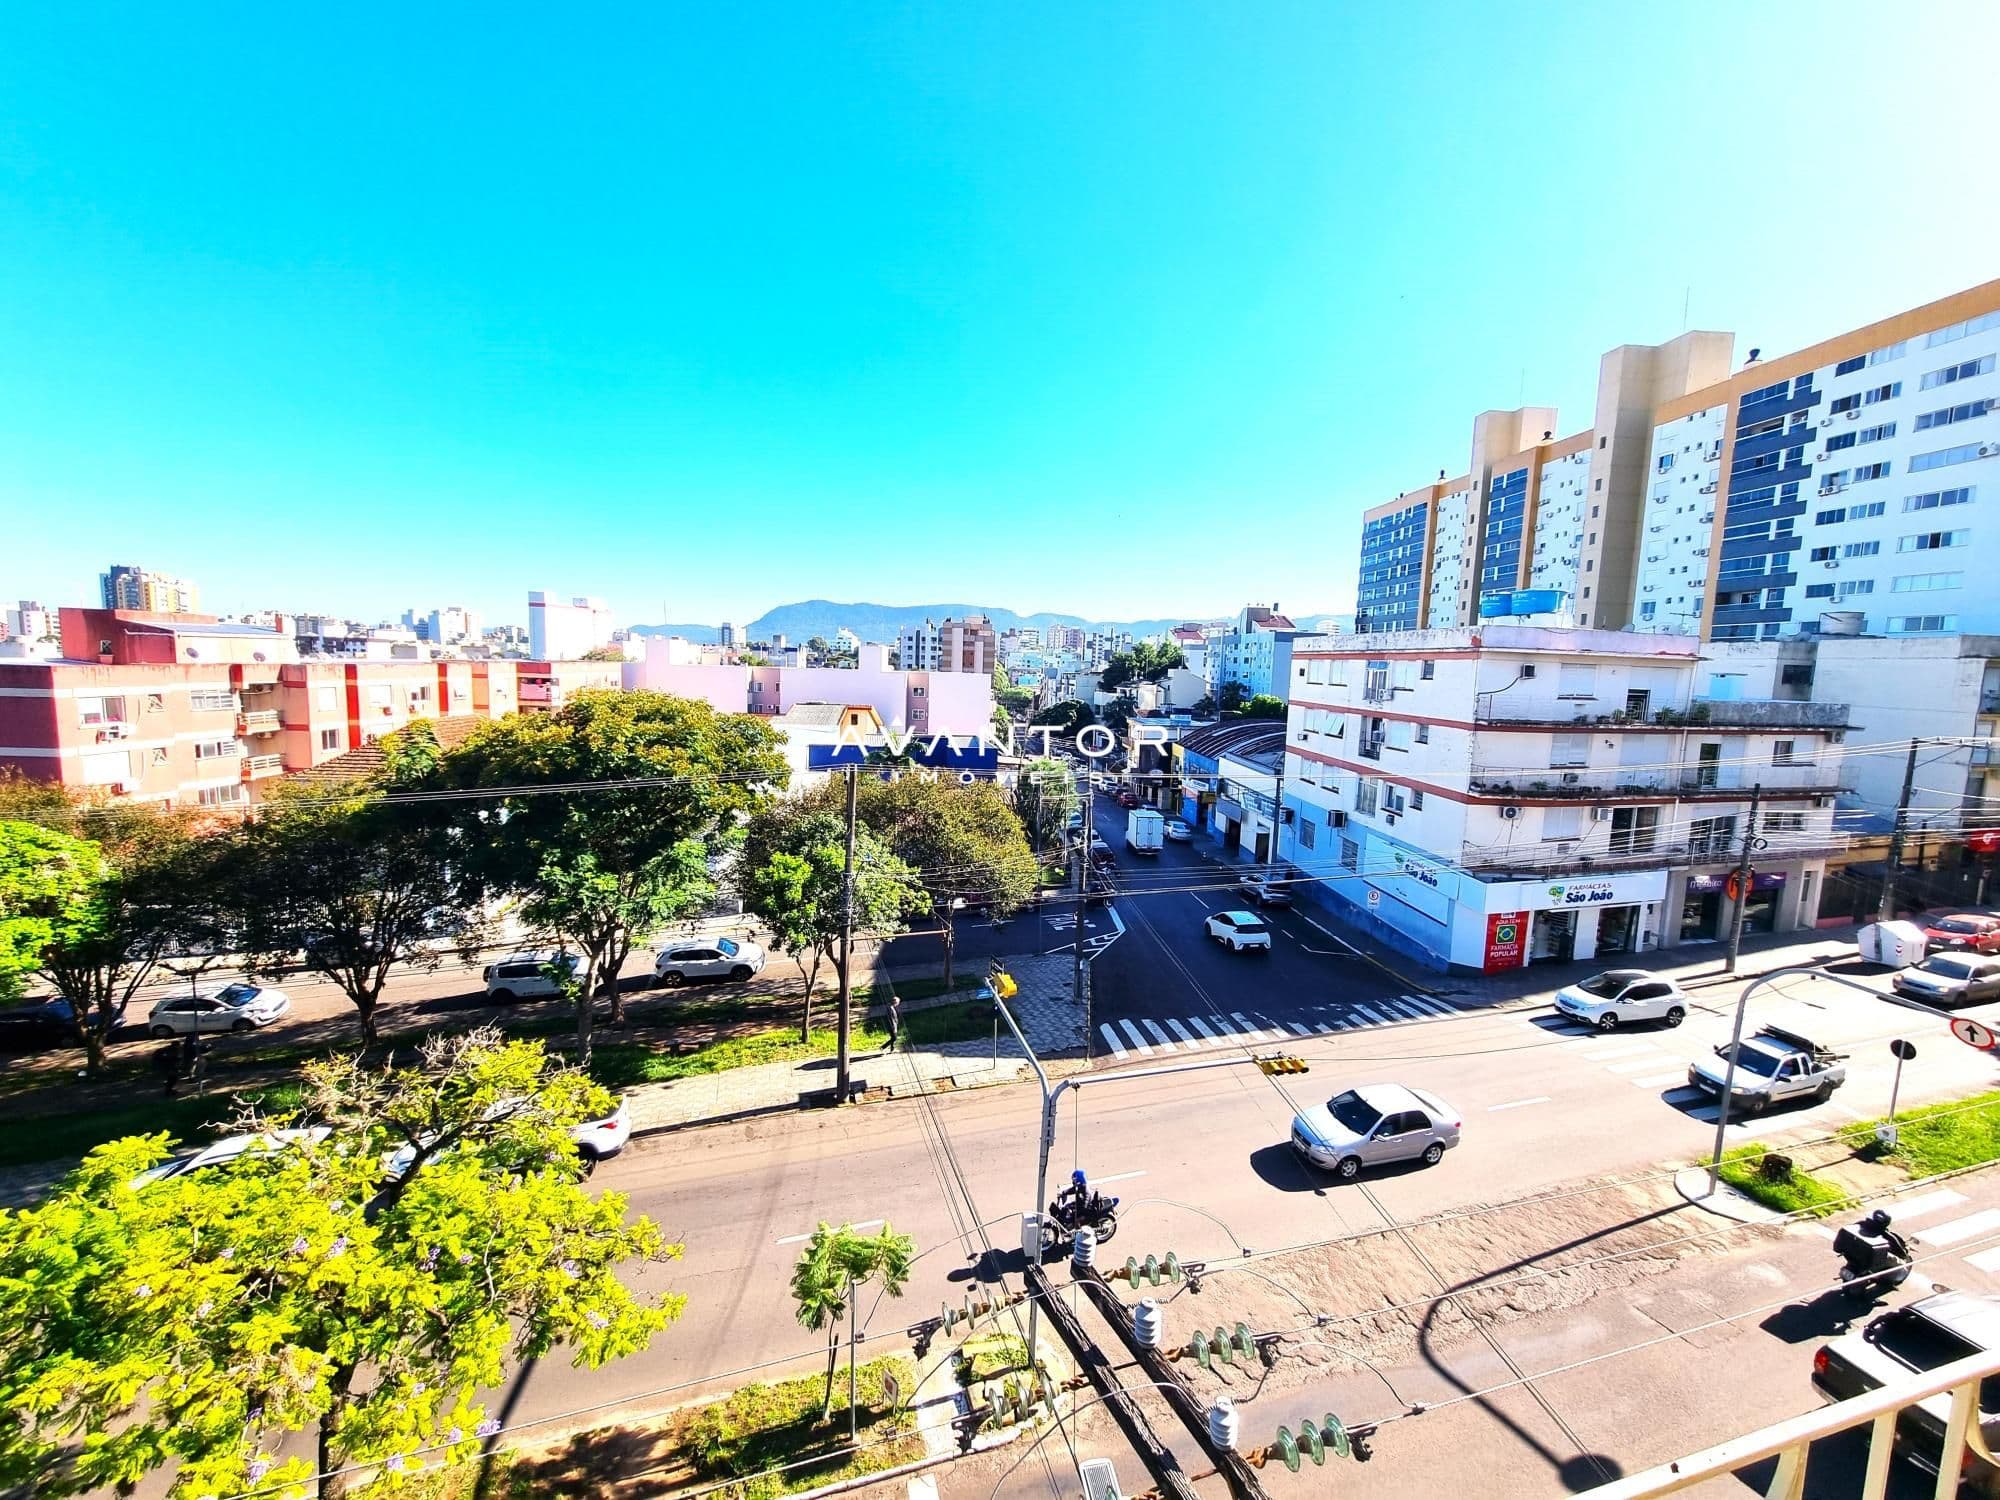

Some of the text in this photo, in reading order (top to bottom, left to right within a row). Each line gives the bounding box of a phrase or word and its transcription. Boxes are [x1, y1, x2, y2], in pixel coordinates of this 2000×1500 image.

[1568, 883, 1612, 891] FARMÁCIAS
[1565, 889, 1614, 903] São João
[1490, 950, 1518, 958] POPULAR
